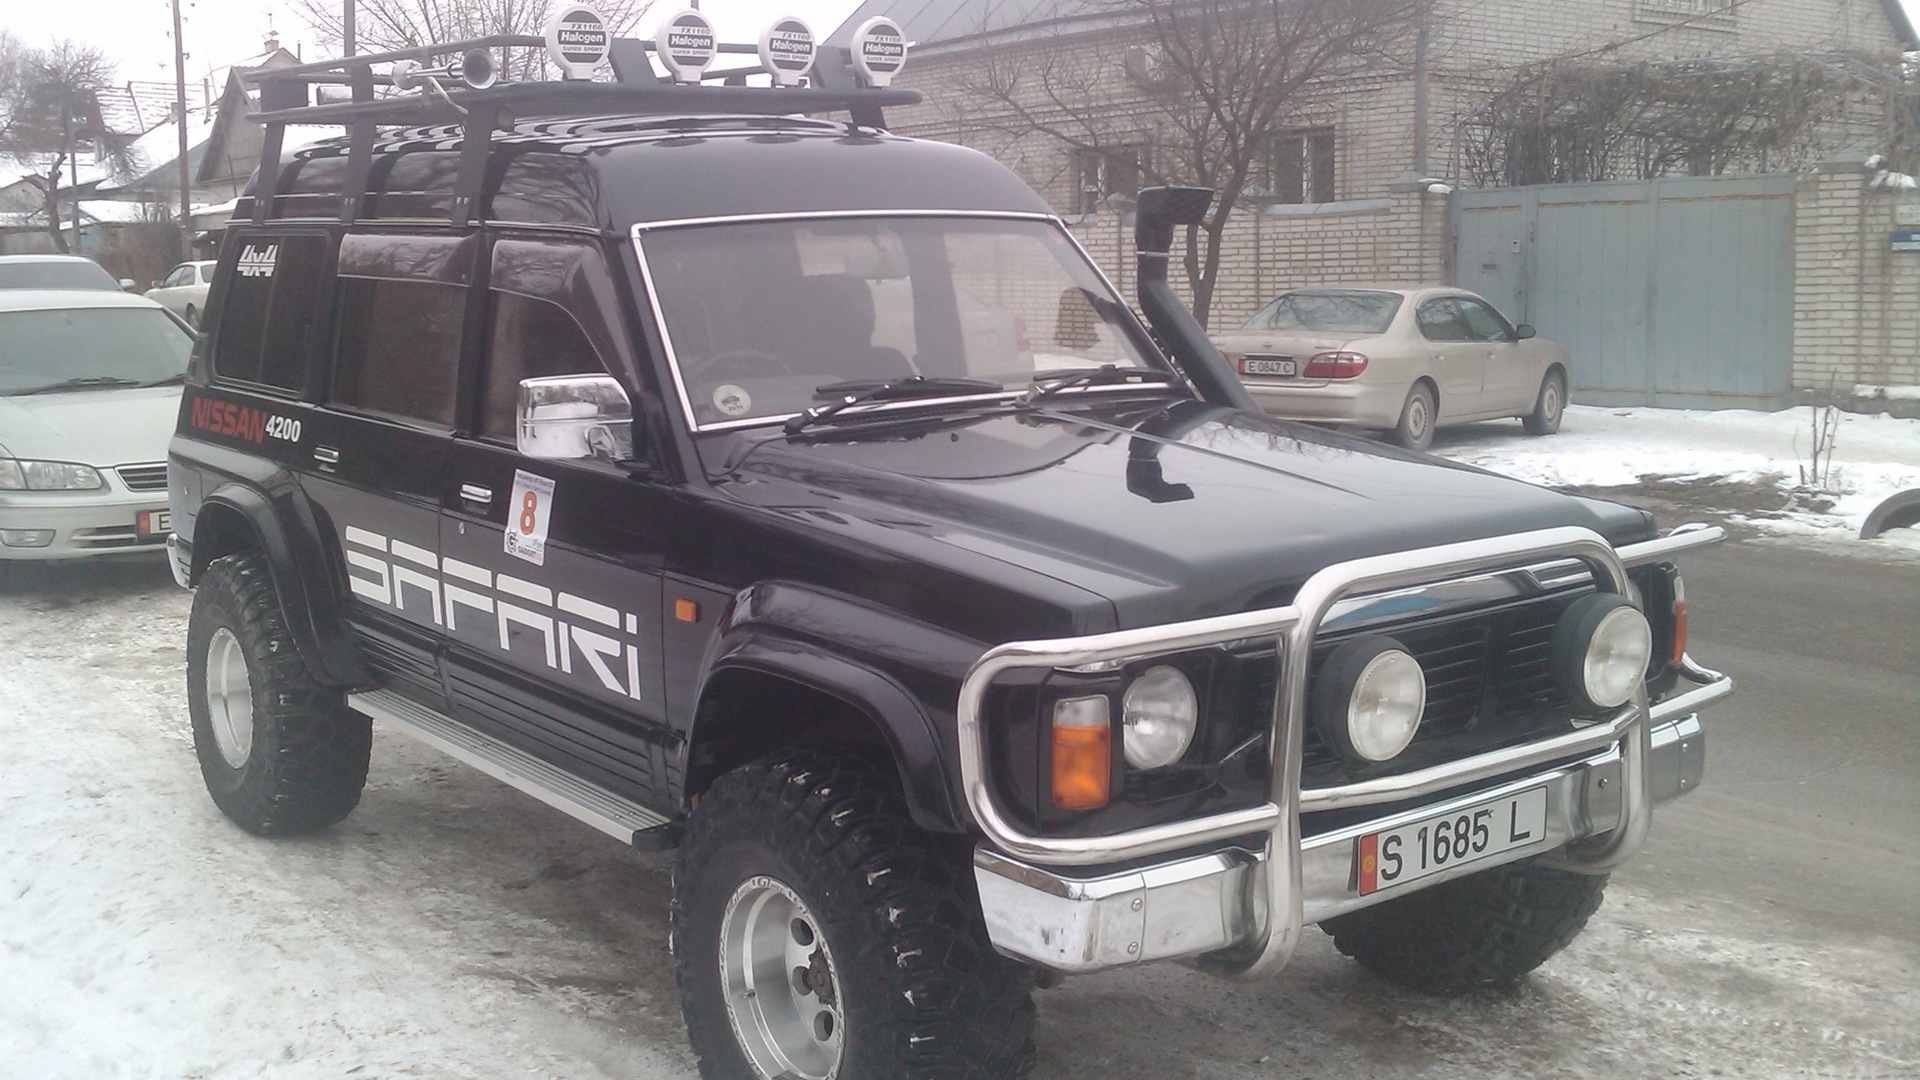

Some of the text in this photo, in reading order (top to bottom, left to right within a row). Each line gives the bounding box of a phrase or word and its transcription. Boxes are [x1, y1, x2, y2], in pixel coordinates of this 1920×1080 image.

[561, 31, 604, 44] Halogen
[671, 35, 711, 48] Halogen
[772, 40, 810, 53] Halogen
[865, 43, 901, 55] Halogen
[1248, 361, 1290, 373] E 0847 C
[190, 396, 301, 445] NISSAN 4200
[520, 491, 537, 535] 8
[345, 525, 641, 701] SAFARI
[1380, 800, 1531, 881] S 1685 L
